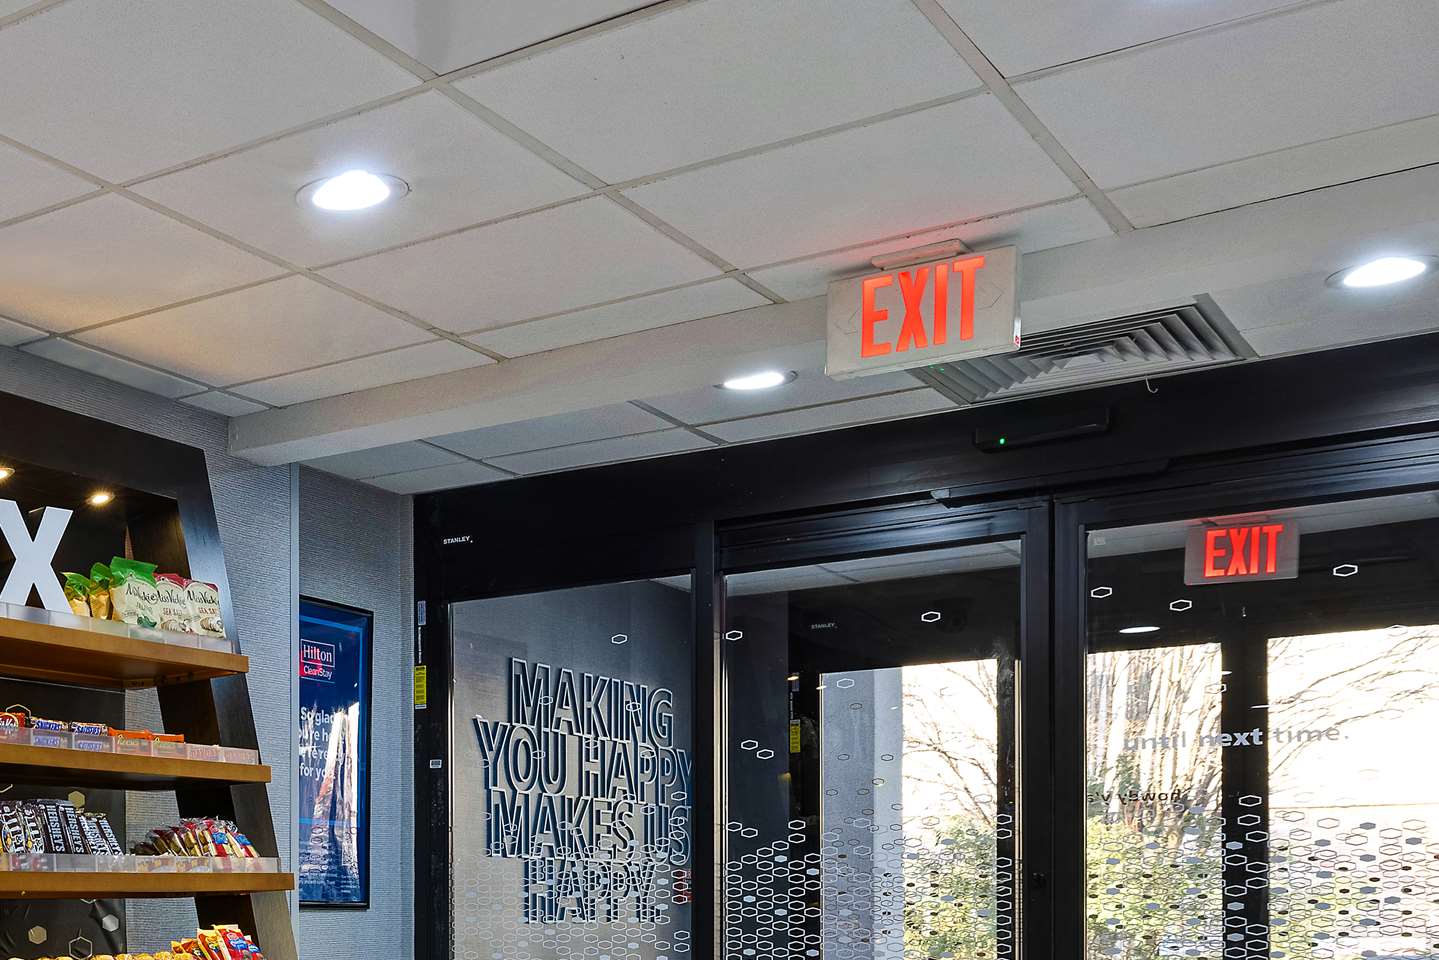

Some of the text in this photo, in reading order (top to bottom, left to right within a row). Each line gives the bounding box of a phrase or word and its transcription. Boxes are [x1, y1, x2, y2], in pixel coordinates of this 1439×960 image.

[861, 256, 985, 359] EXIT
[1203, 524, 1284, 579] EXIT
[303, 645, 333, 663] Hilton
[303, 665, 333, 680] CleanStay
[510, 657, 673, 750] MAKING
[474, 717, 692, 807] YOU HAPPY
[1123, 725, 1349, 750] until next time.
[300, 762, 314, 777] for
[488, 788, 692, 866] MAKES US
[526, 857, 662, 924] HAPPY
